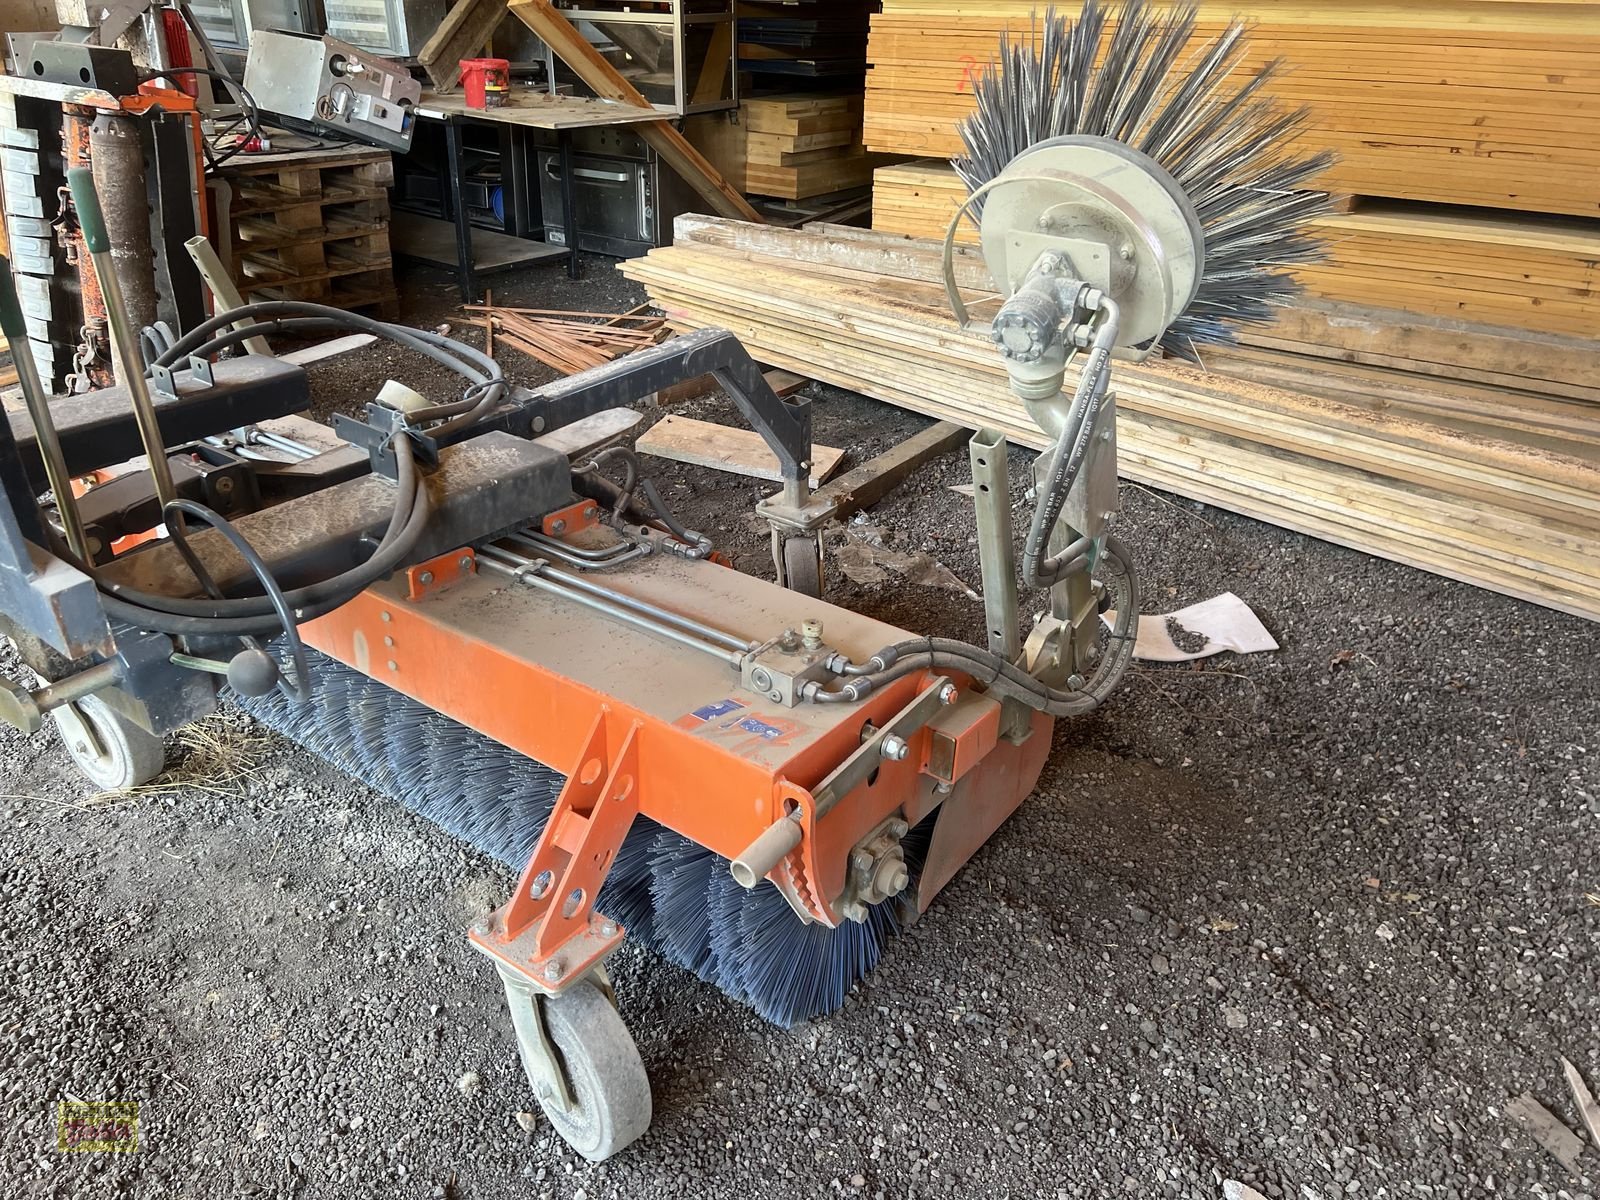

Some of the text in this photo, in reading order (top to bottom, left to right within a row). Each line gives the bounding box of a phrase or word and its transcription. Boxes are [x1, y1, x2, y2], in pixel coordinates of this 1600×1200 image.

[1077, 375, 1096, 418] HANSA-FLEX
[1095, 361, 1102, 372] HD
[1069, 465, 1076, 473] 12
[1075, 446, 1083, 458] WP
[1080, 435, 1088, 446] 275
[1085, 421, 1093, 435] BAR
[1048, 492, 1056, 506] BAR
